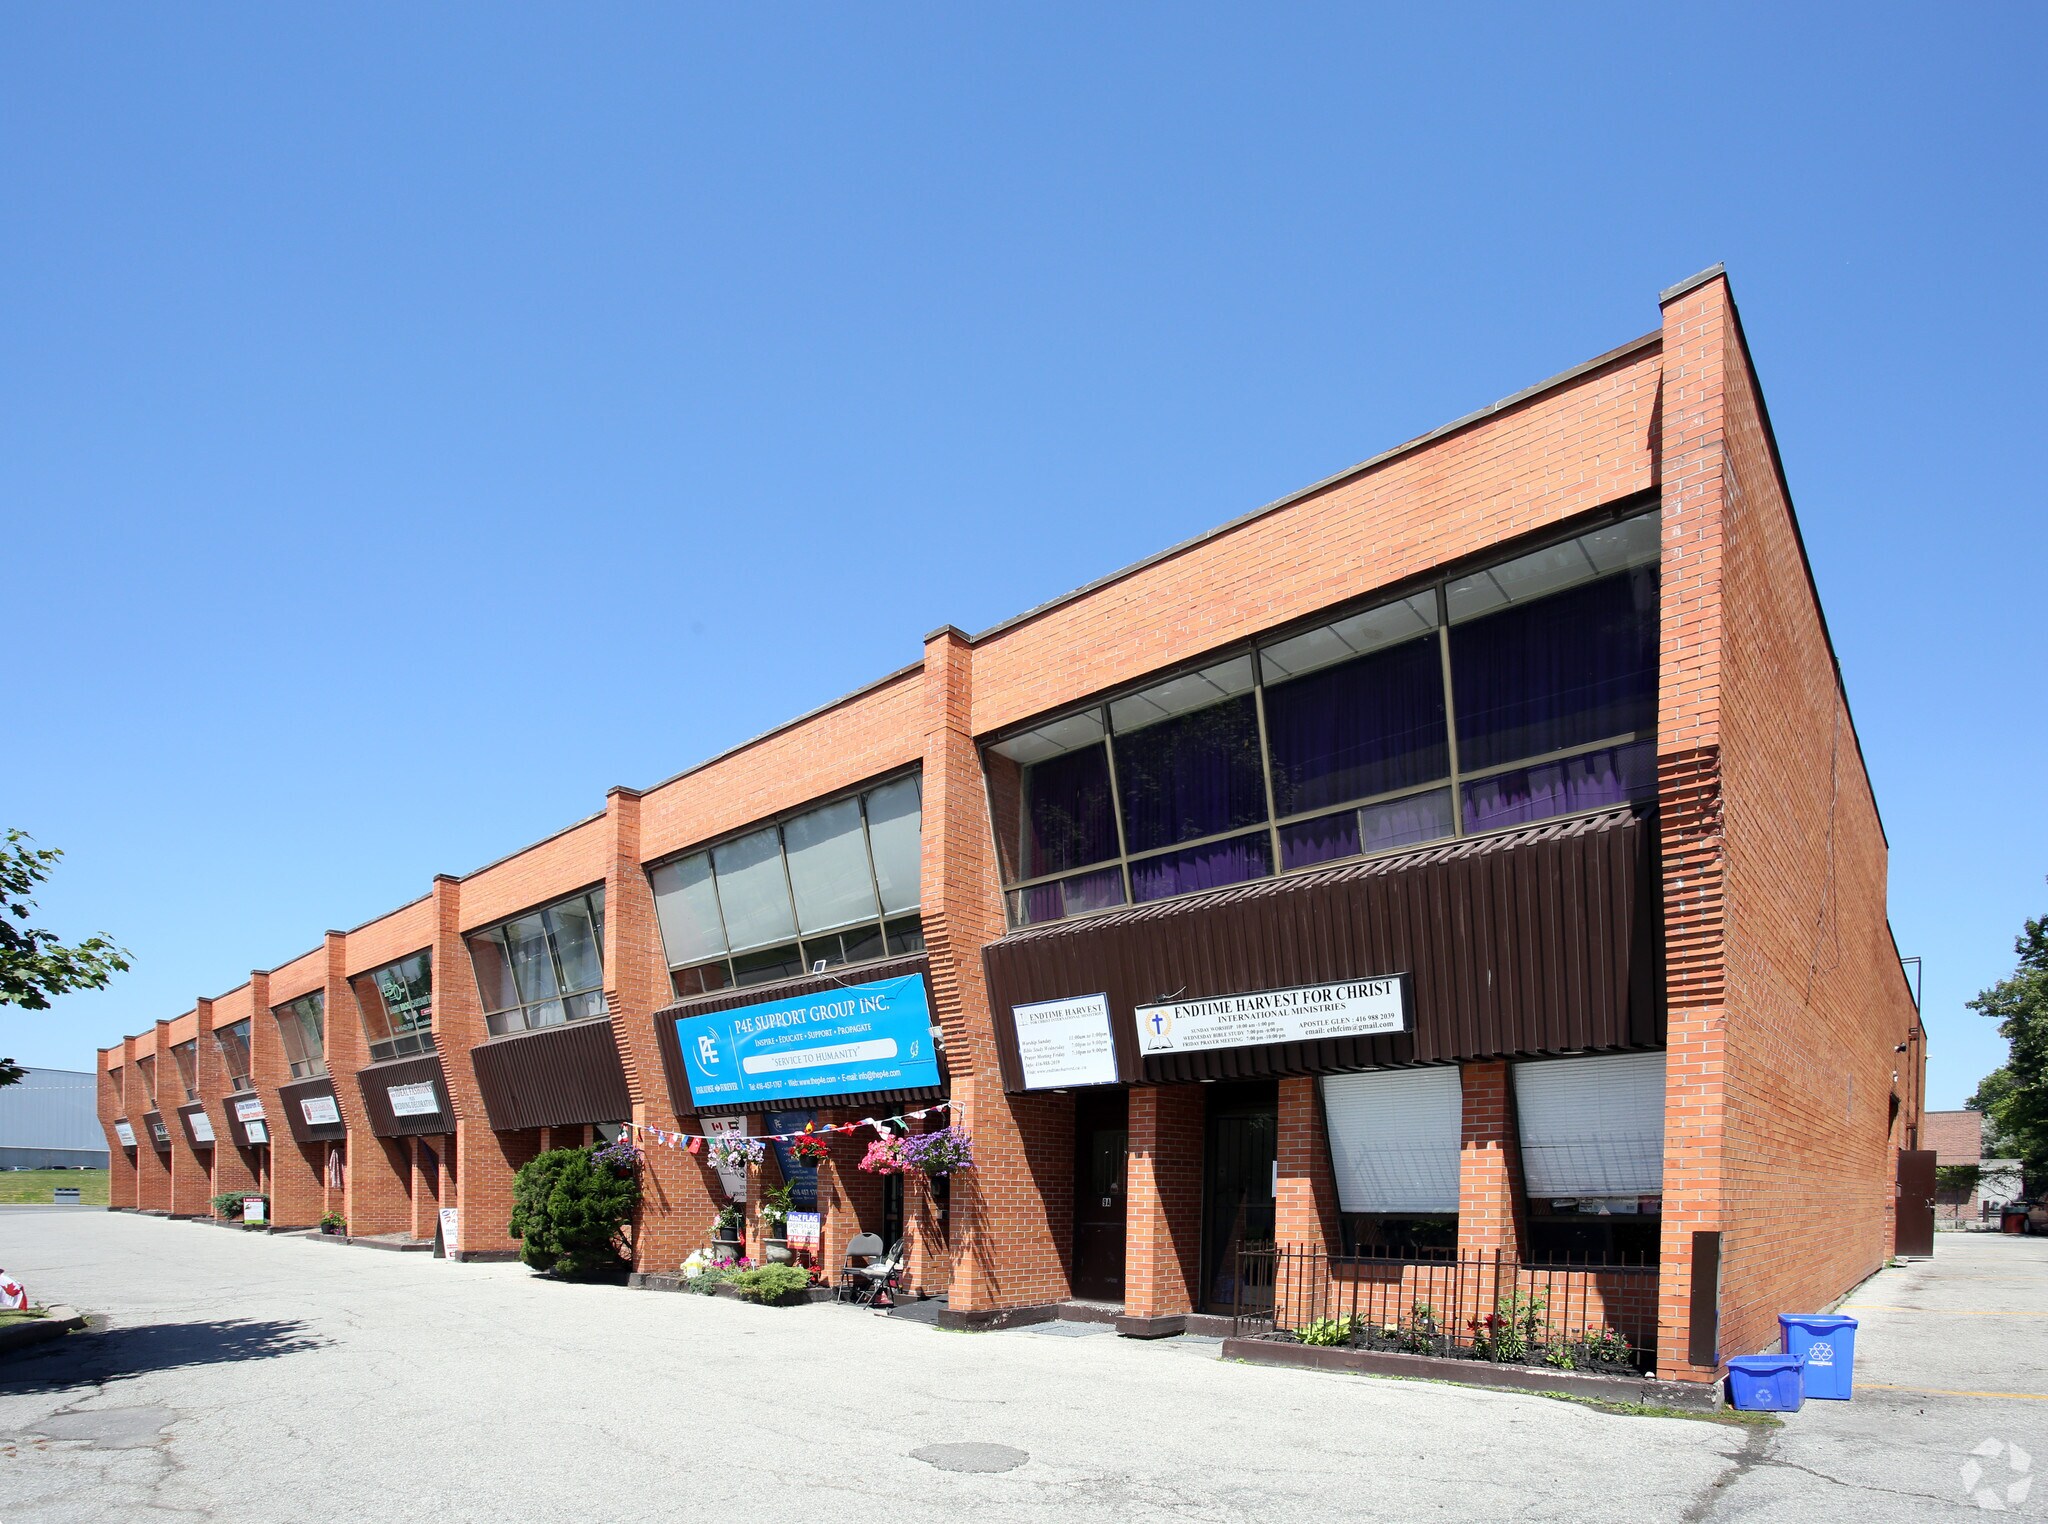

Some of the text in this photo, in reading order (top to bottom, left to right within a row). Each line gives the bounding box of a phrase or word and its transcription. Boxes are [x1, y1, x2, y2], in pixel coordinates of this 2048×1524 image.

[1174, 980, 1393, 1019] ENDTIME HARVEST FOR CHRIST
[734, 994, 890, 1034] P4E SUPPORT GROUP INC.
[1029, 1004, 1103, 1021] ENDTIME HARVEST
[1218, 1002, 1347, 1023] INTERNATIONAL MINISTRIES
[1299, 1019, 1330, 1028] APOSTLE
[1330, 1018, 1351, 1026] GLEN
[1380, 1012, 1395, 1020] 2039
[1326, 1021, 1394, 1032] ethfcim@gmail.com
[754, 1023, 872, 1047] INSPIRE EDUCATE SUPPORT PROPAGATE
[1183, 1033, 1212, 1041] WEDNESDAY
[803, 1053, 814, 1063] TO
[788, 1213, 818, 1222] AtoZ FLAG
